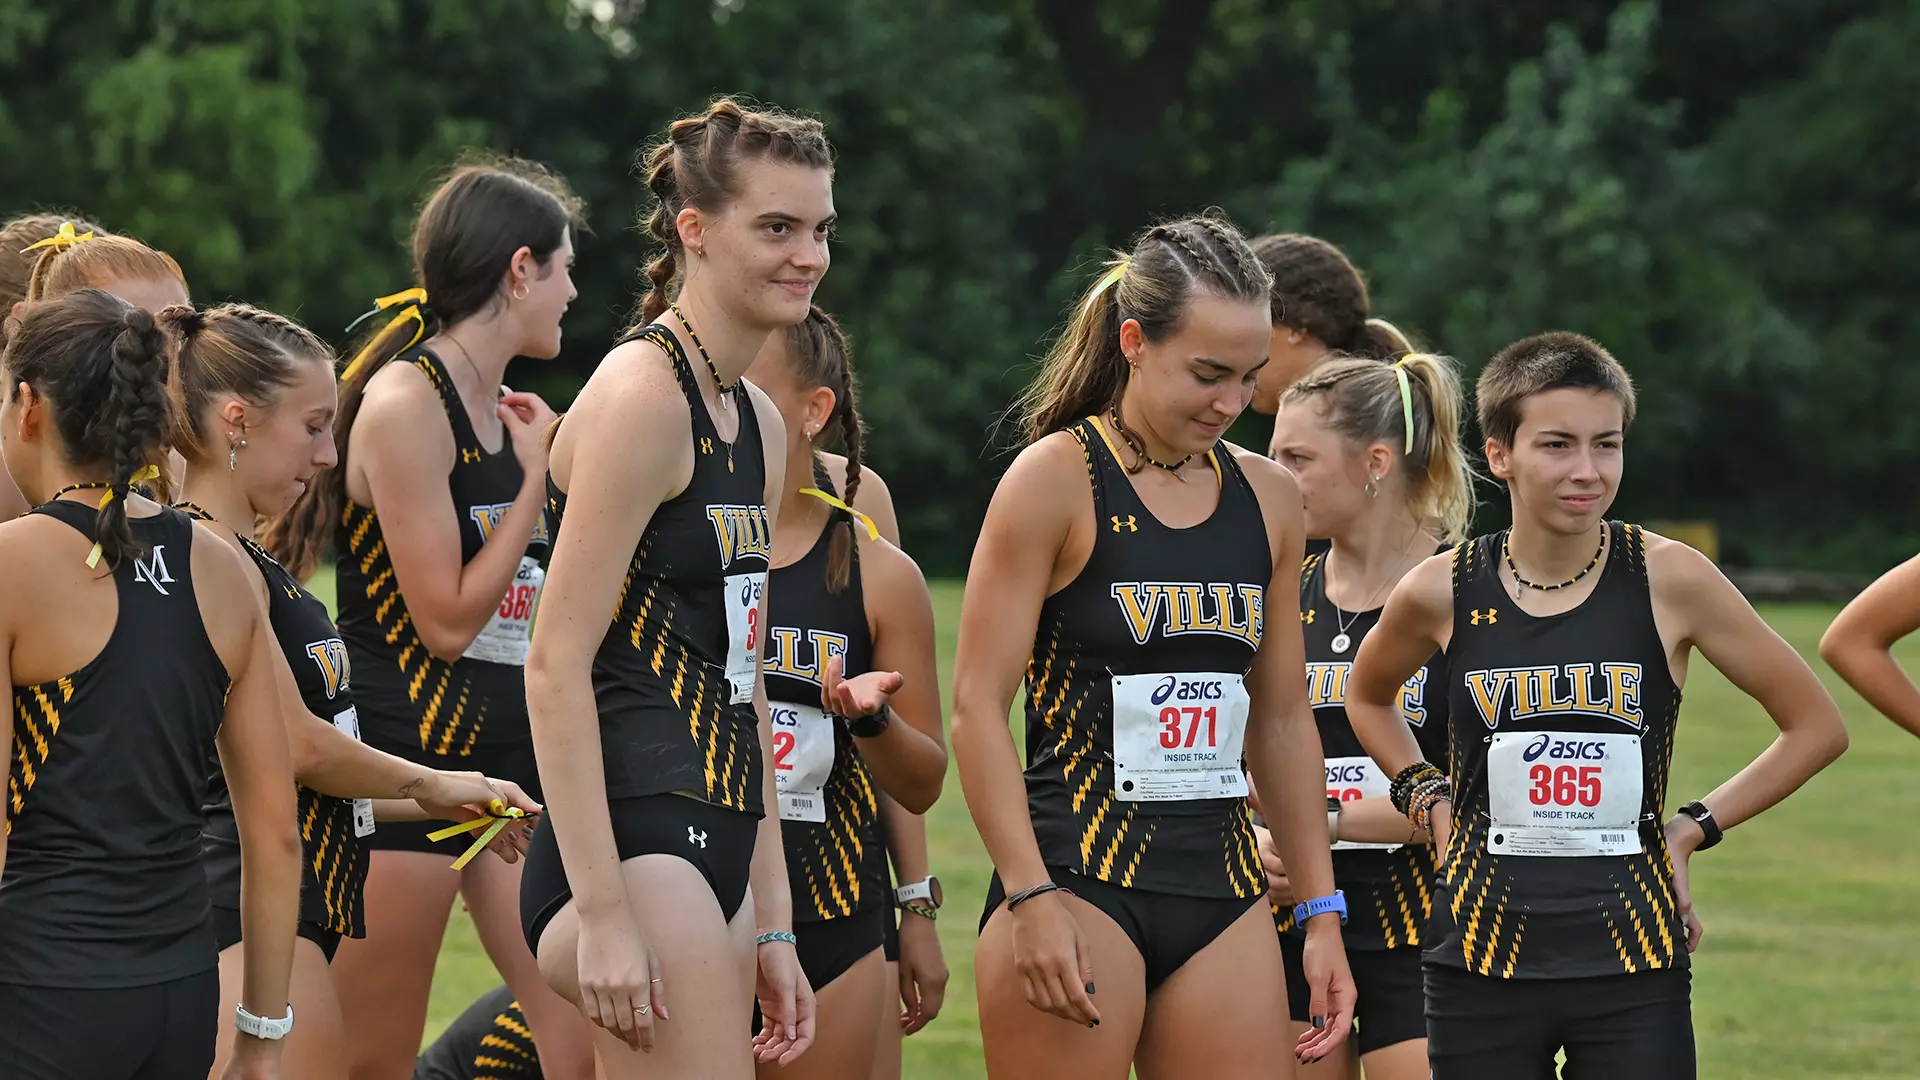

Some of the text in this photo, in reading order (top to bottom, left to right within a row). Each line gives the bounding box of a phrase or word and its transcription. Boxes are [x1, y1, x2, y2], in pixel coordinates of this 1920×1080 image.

[706, 504, 771, 569] VILL
[1111, 582, 1263, 651] VILLE
[1465, 661, 1644, 730] VILLE
[1159, 706, 1217, 749] 371
[1164, 752, 1217, 762] INSIDE TRACK
[1529, 764, 1602, 807] 365
[1533, 810, 1595, 820] INSIDE TRACK
